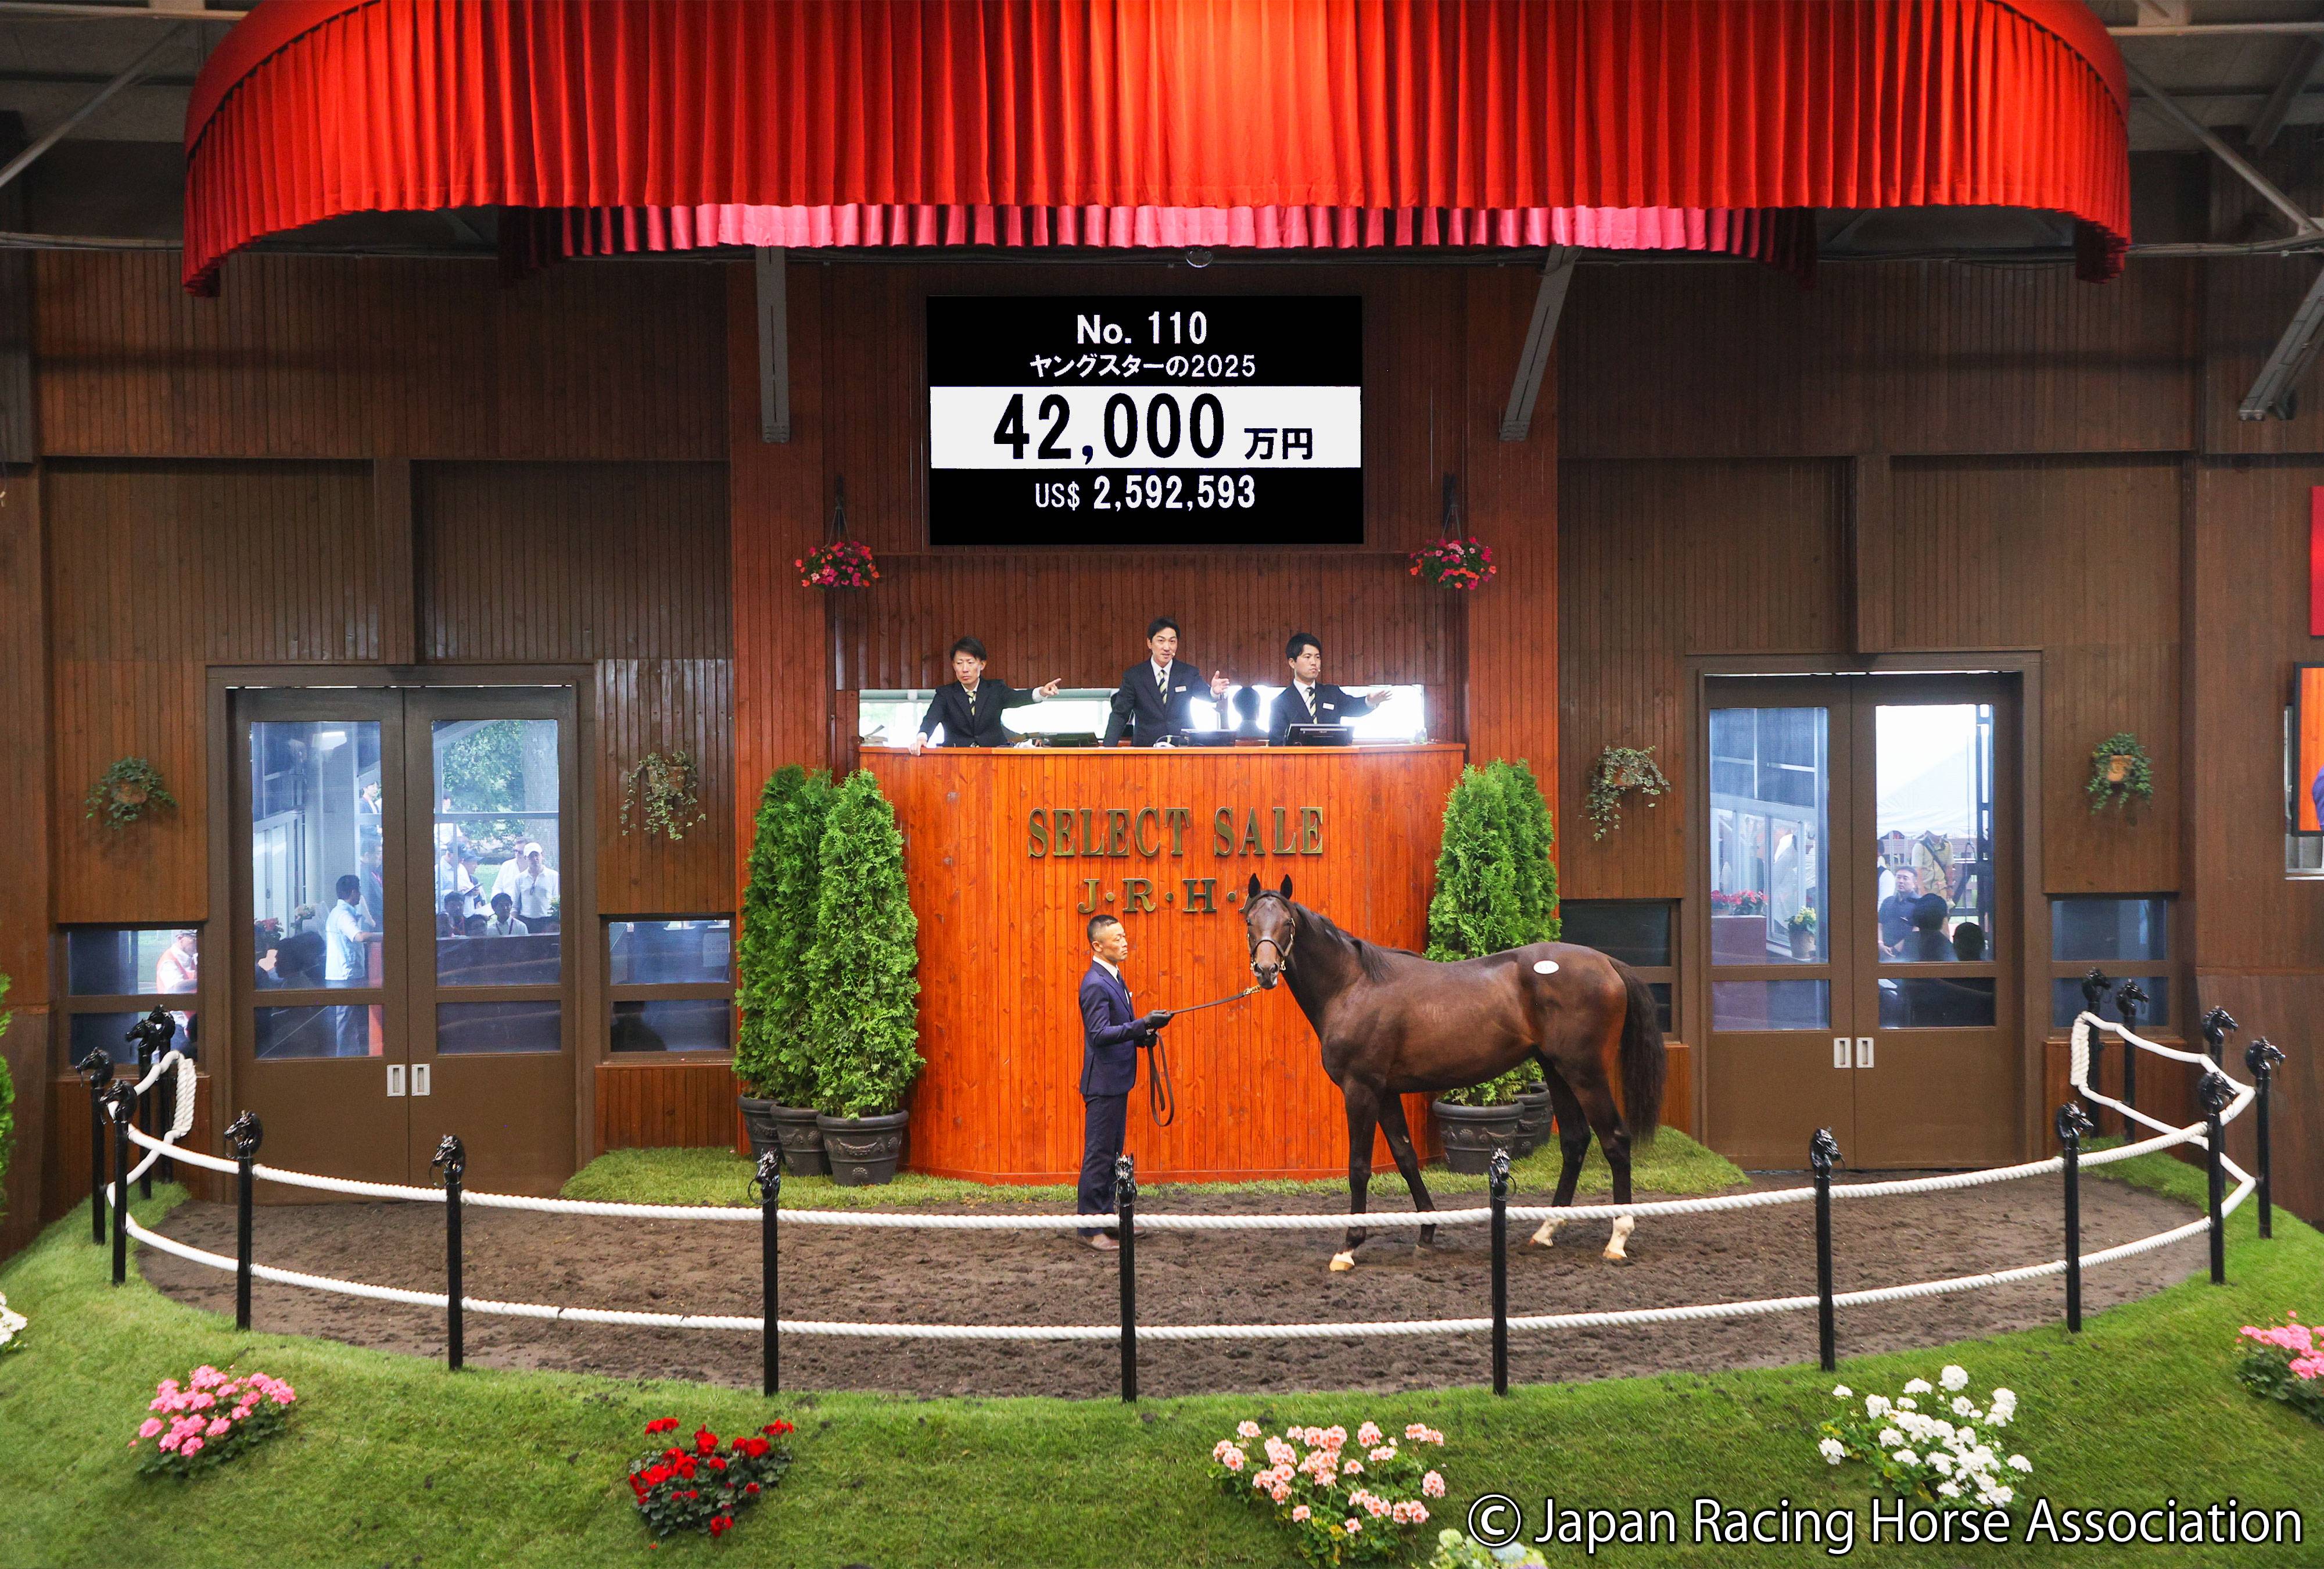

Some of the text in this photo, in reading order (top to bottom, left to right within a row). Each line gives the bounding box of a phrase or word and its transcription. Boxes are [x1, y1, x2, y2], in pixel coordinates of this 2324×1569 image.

[1077, 311, 1207, 345] No. 110
[1030, 353, 1256, 378] ヤングスターの2025
[994, 393, 1314, 465] 42,000 万円
[1035, 474, 1255, 512] US$ 2,592,593
[1028, 806, 1324, 857] SELECT SALE
